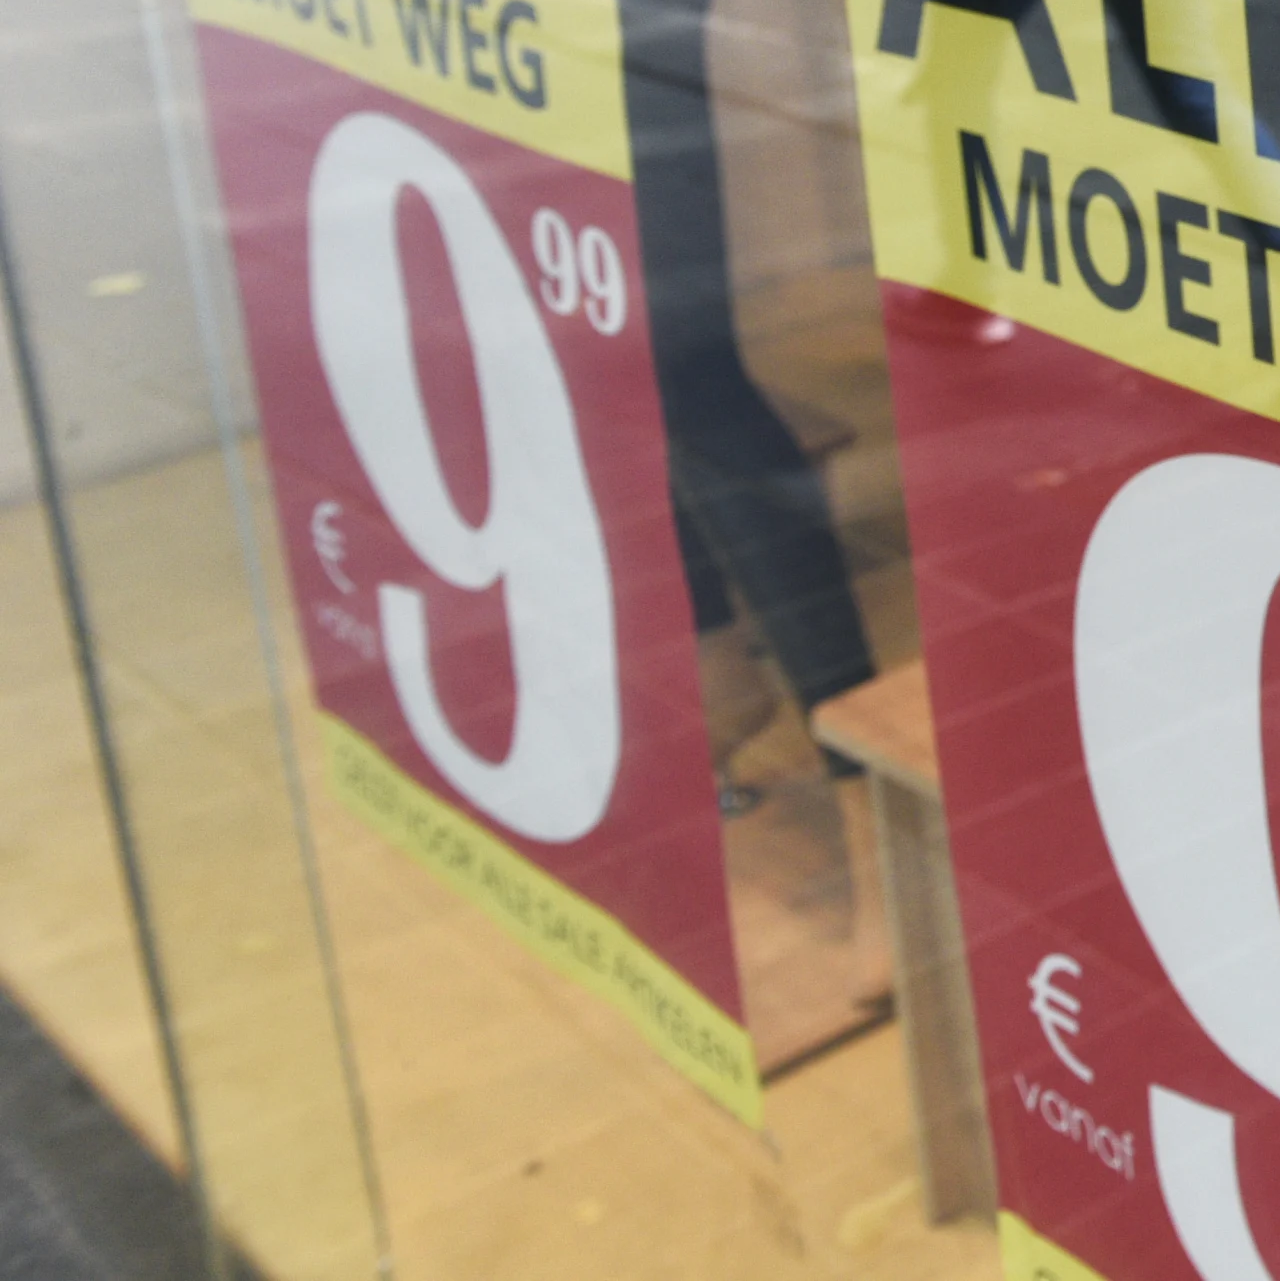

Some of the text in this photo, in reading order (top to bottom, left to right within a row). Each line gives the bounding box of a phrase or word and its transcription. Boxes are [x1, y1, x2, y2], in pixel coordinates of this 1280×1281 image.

[307, 110, 622, 842] 9
[531, 207, 623, 336] 99
[1027, 953, 1094, 1083] €
[1013, 1072, 1135, 1182] vanaf
